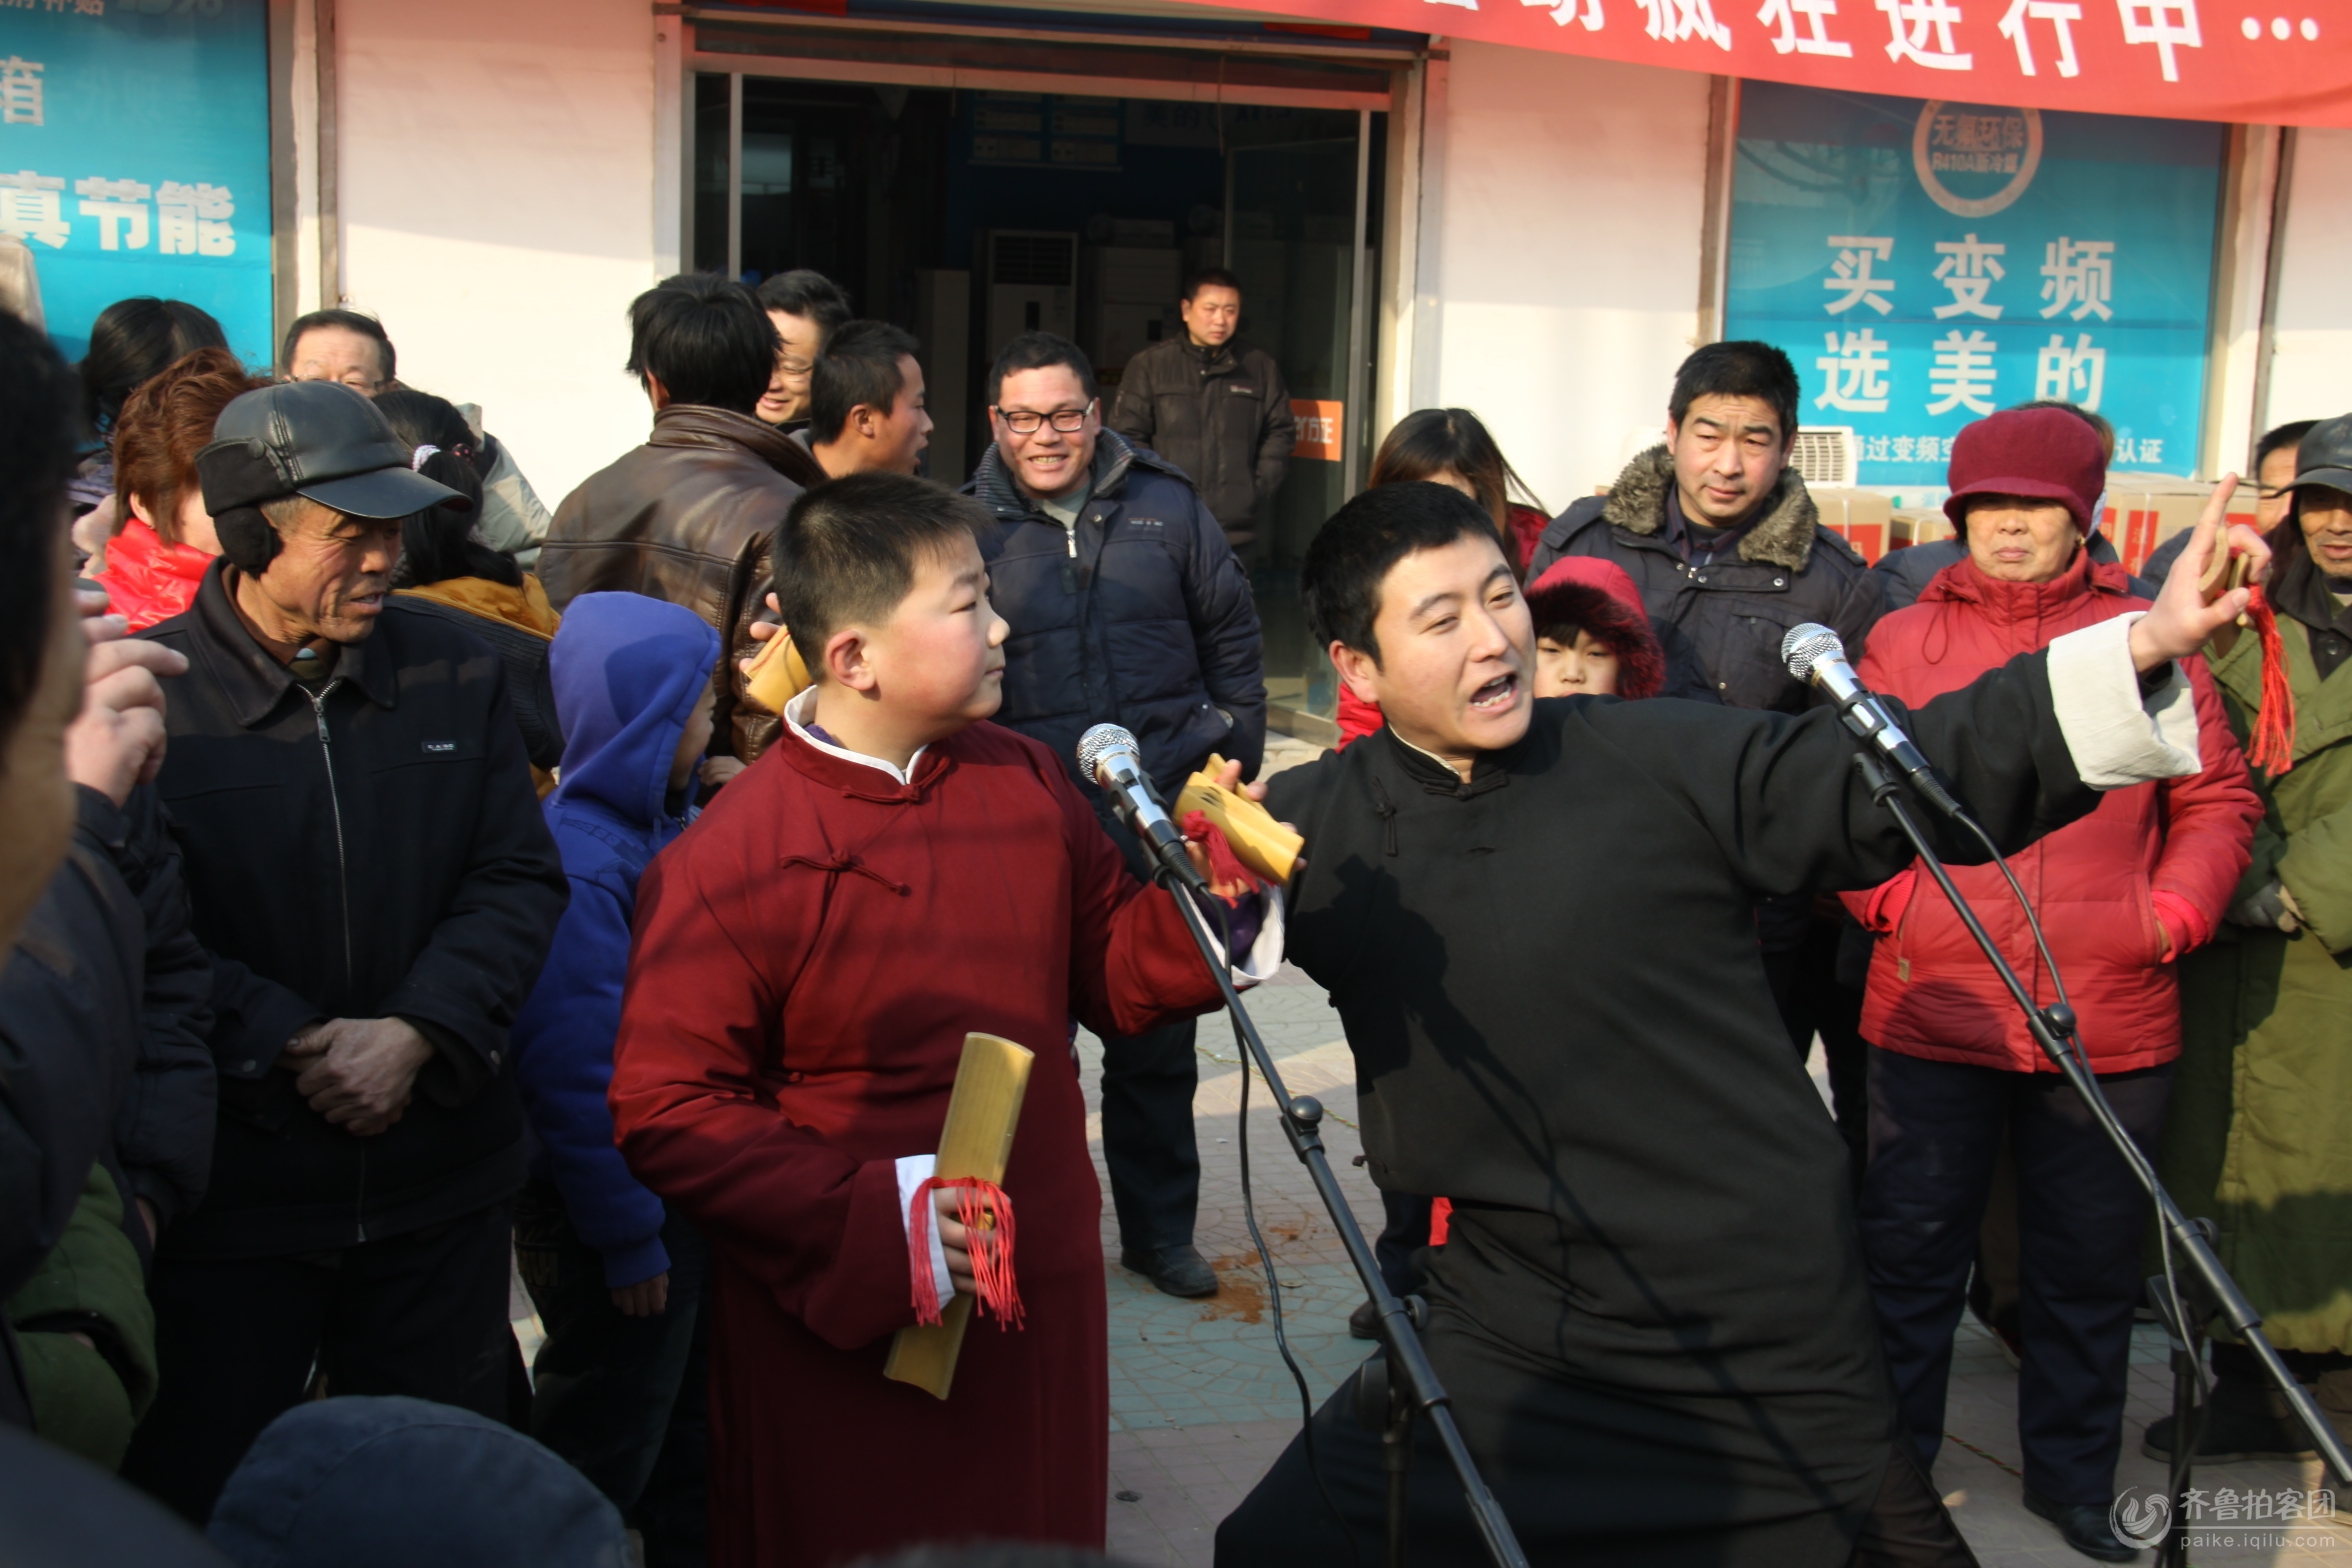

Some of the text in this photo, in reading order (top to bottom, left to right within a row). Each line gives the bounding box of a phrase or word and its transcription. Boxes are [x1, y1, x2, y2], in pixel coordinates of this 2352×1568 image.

[1932, 114, 2024, 148] 无氟环保
[0, 170, 236, 257] 真节能
[1823, 233, 2115, 322] 买变频
[1813, 328, 2106, 417] 选美的
[2116, 438, 2165, 464] 认证
